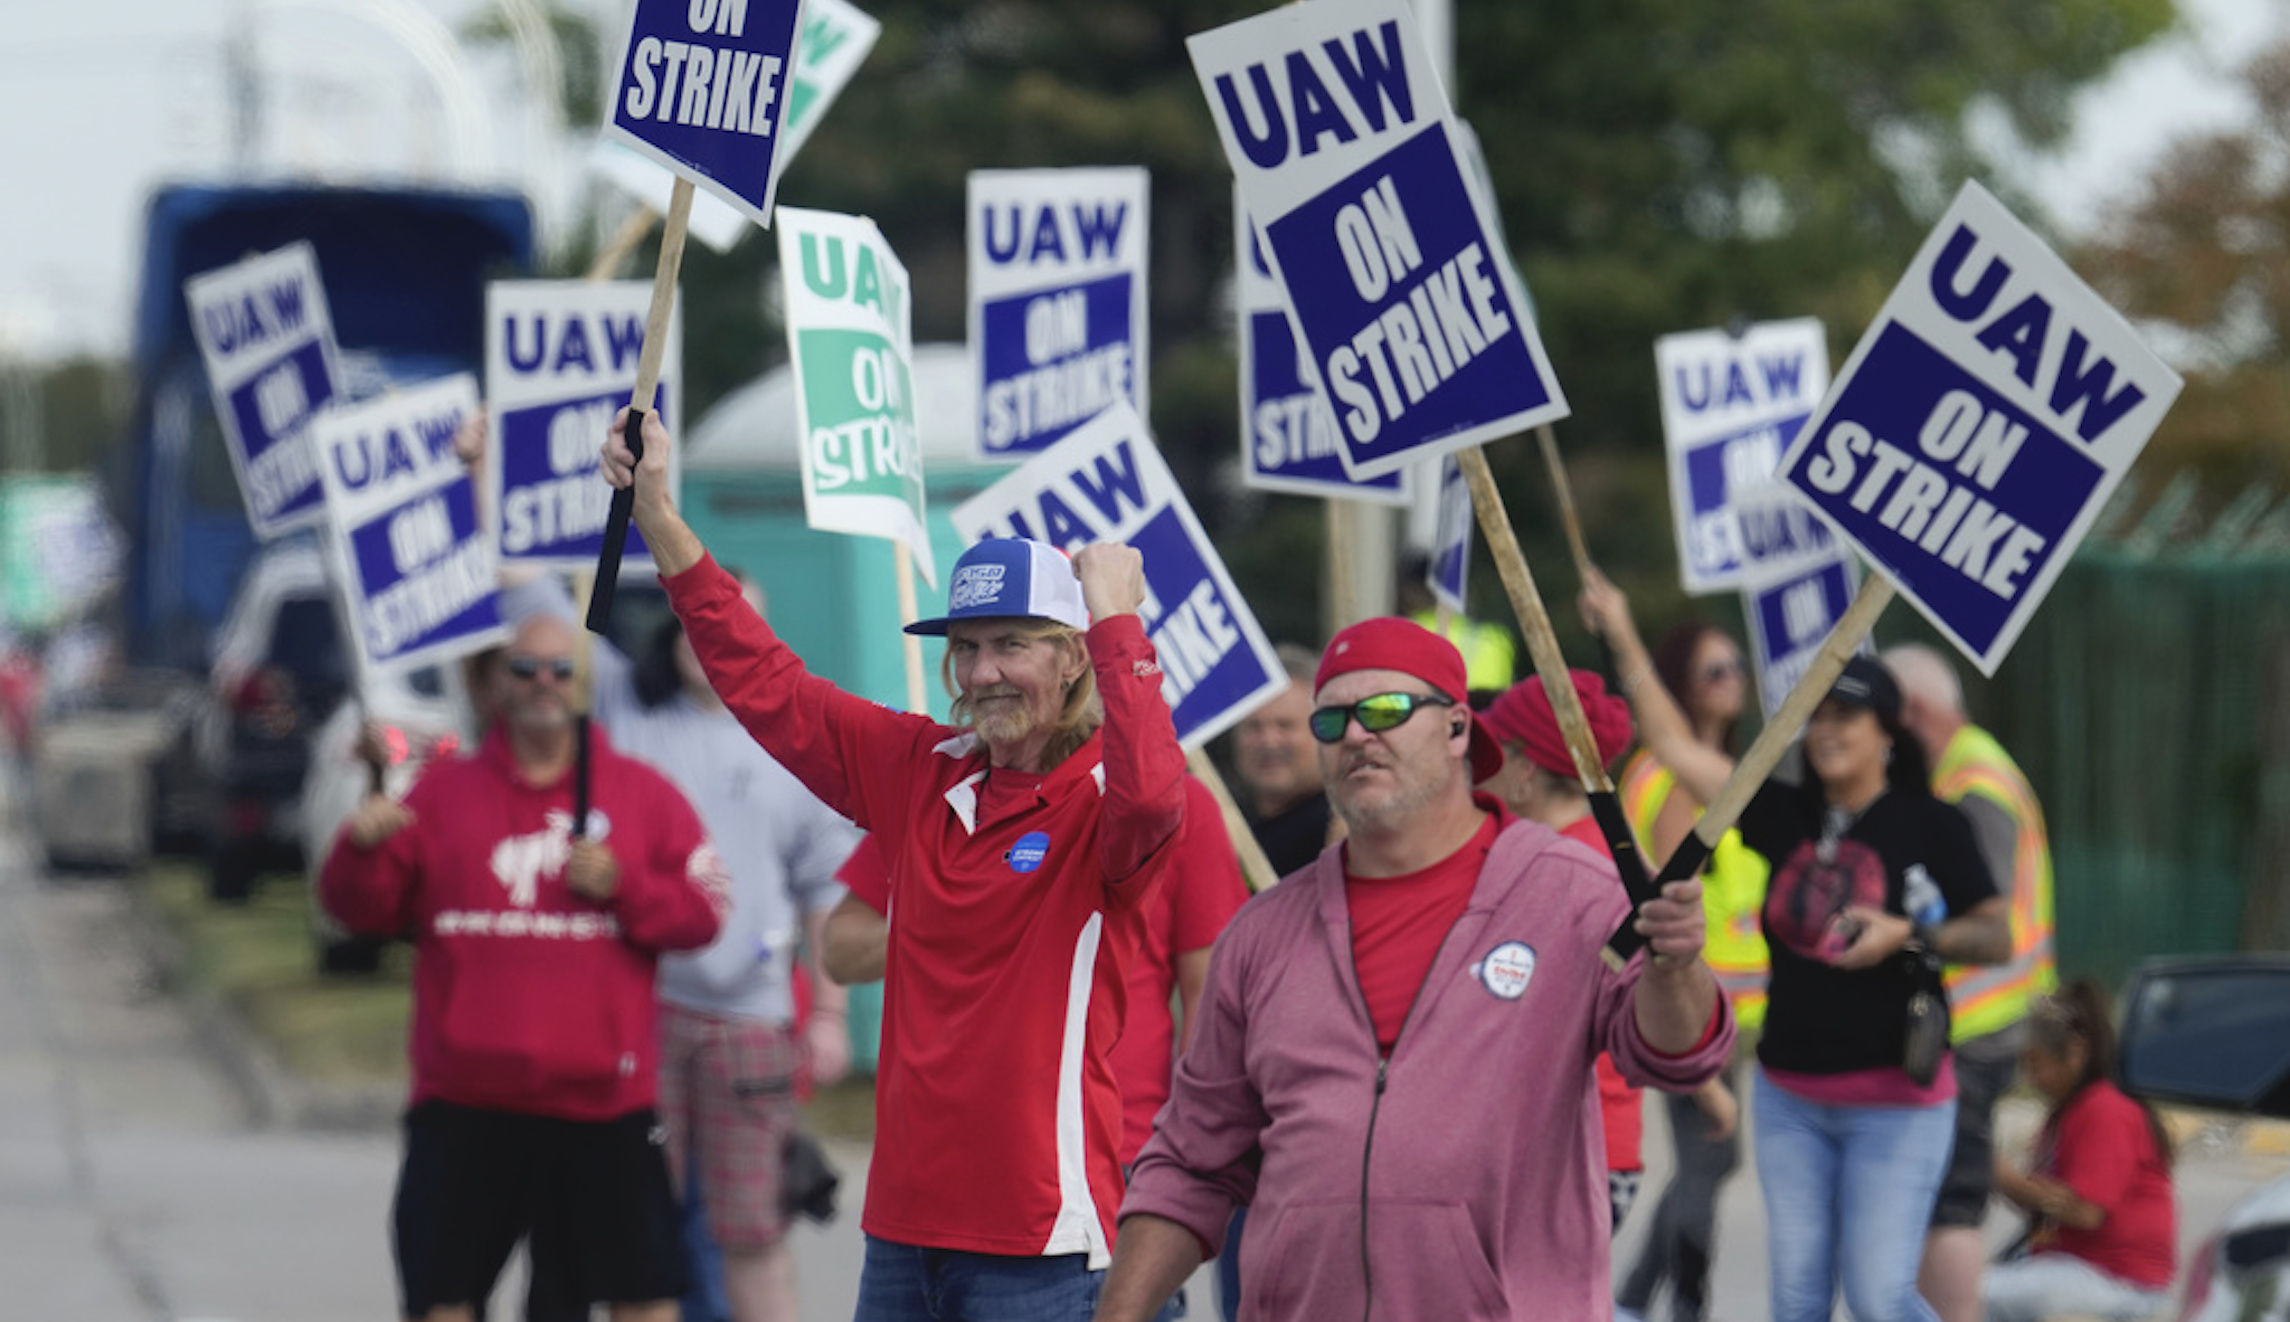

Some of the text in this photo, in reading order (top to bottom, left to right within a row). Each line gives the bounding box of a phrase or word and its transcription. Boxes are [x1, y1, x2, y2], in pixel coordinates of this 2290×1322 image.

[626, 37, 782, 137] STRIKE
[1214, 19, 1416, 169] UAW
[983, 204, 1128, 264] UAW
[1335, 174, 1423, 303] ON
[202, 278, 305, 354] UAW
[1023, 289, 1087, 367] ON
[1327, 242, 1511, 444] STRIKE
[1929, 222, 2147, 444] UAW
[984, 341, 1132, 450] STRIKE
[1676, 355, 1804, 411] UAW
[1917, 389, 2029, 490] ON
[1807, 420, 2046, 601] STRIKE
